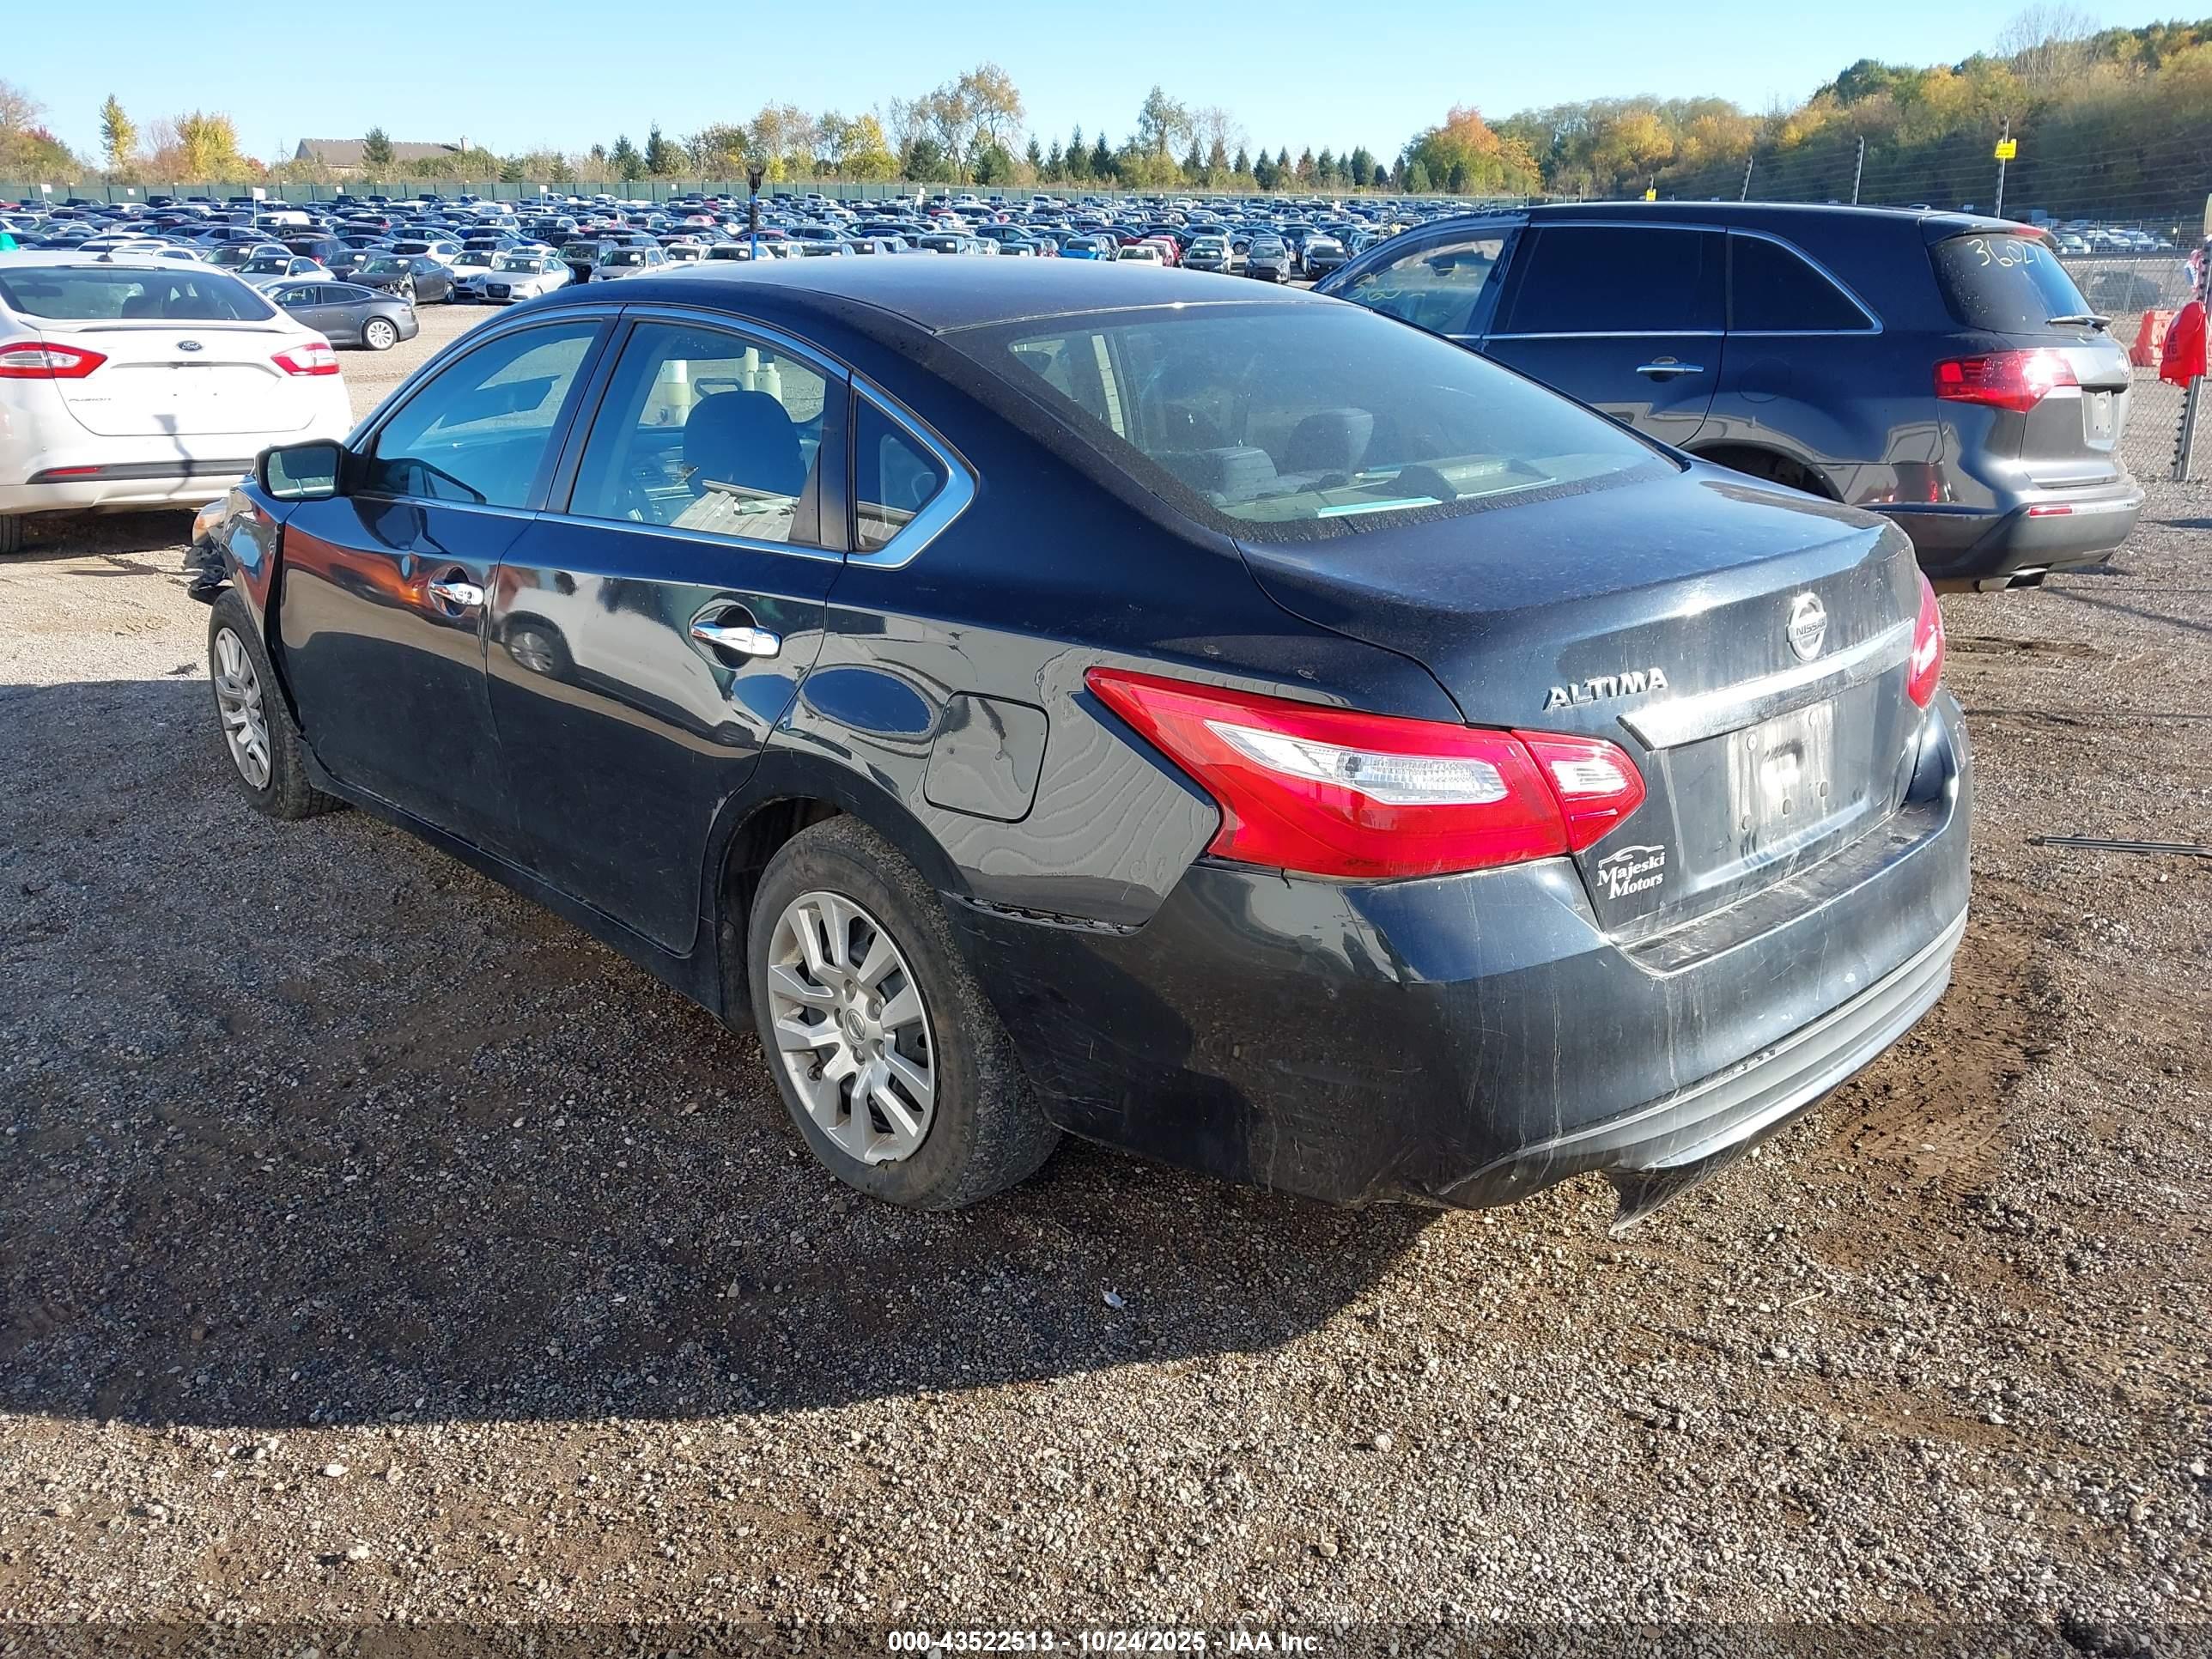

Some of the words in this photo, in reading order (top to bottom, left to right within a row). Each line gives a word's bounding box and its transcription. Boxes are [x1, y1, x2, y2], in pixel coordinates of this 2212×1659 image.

[1543, 667, 1668, 711] ALTIMA
[1597, 852, 1665, 886] Majeski
[1608, 872, 1663, 900] Motors
